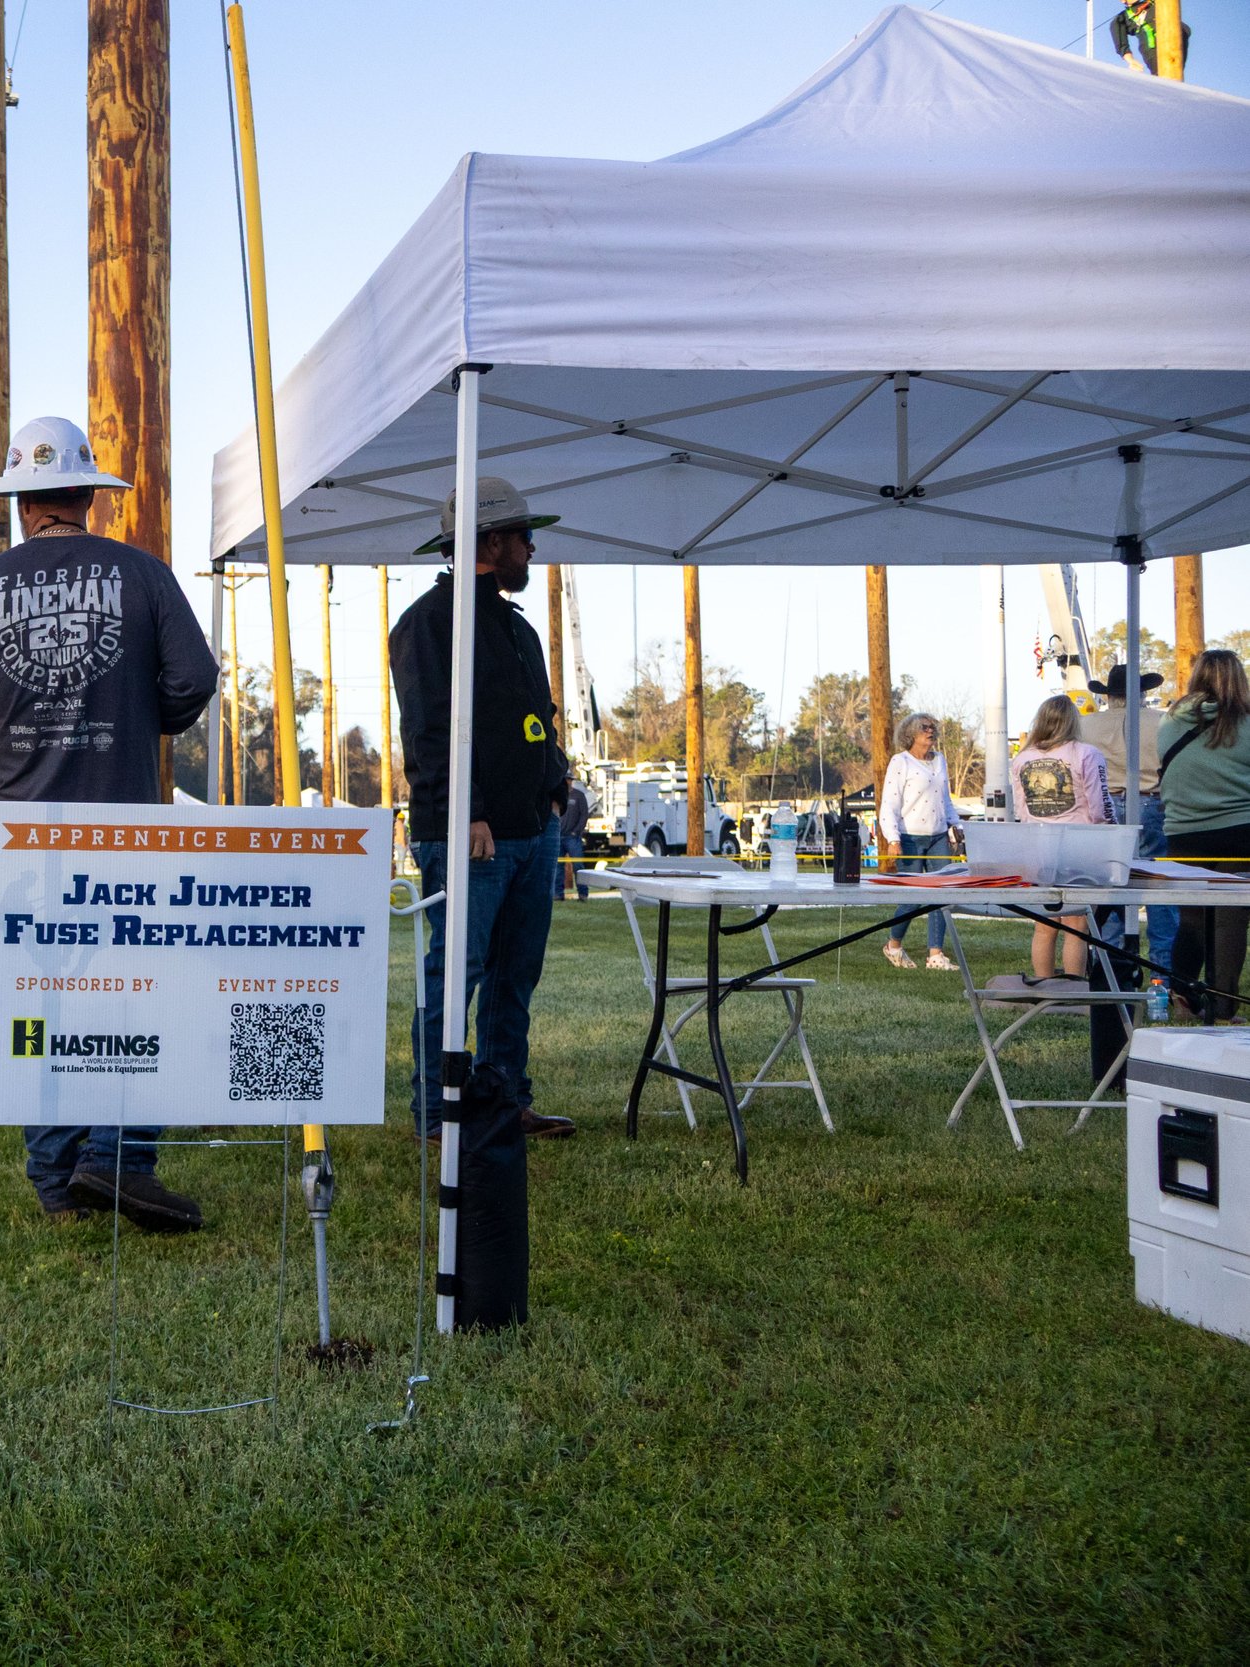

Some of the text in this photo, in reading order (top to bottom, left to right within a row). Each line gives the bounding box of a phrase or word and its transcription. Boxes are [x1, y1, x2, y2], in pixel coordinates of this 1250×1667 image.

[28, 612, 89, 650] 25
[30, 644, 88, 667] ANNUAL
[63, 680, 88, 694] MARCH
[108, 647, 125, 668] 2026
[26, 827, 347, 850] APPRENTICE EVENT
[62, 873, 312, 908] JACK JUMPER
[3, 913, 366, 948] FUSE REPLACEMENT
[15, 976, 159, 993] SPONSORED BY:
[218, 978, 340, 993] EVENT SPECS
[50, 1034, 160, 1057] HASTINGS
[51, 1065, 159, 1075] Hot Line Tools & Equipment
